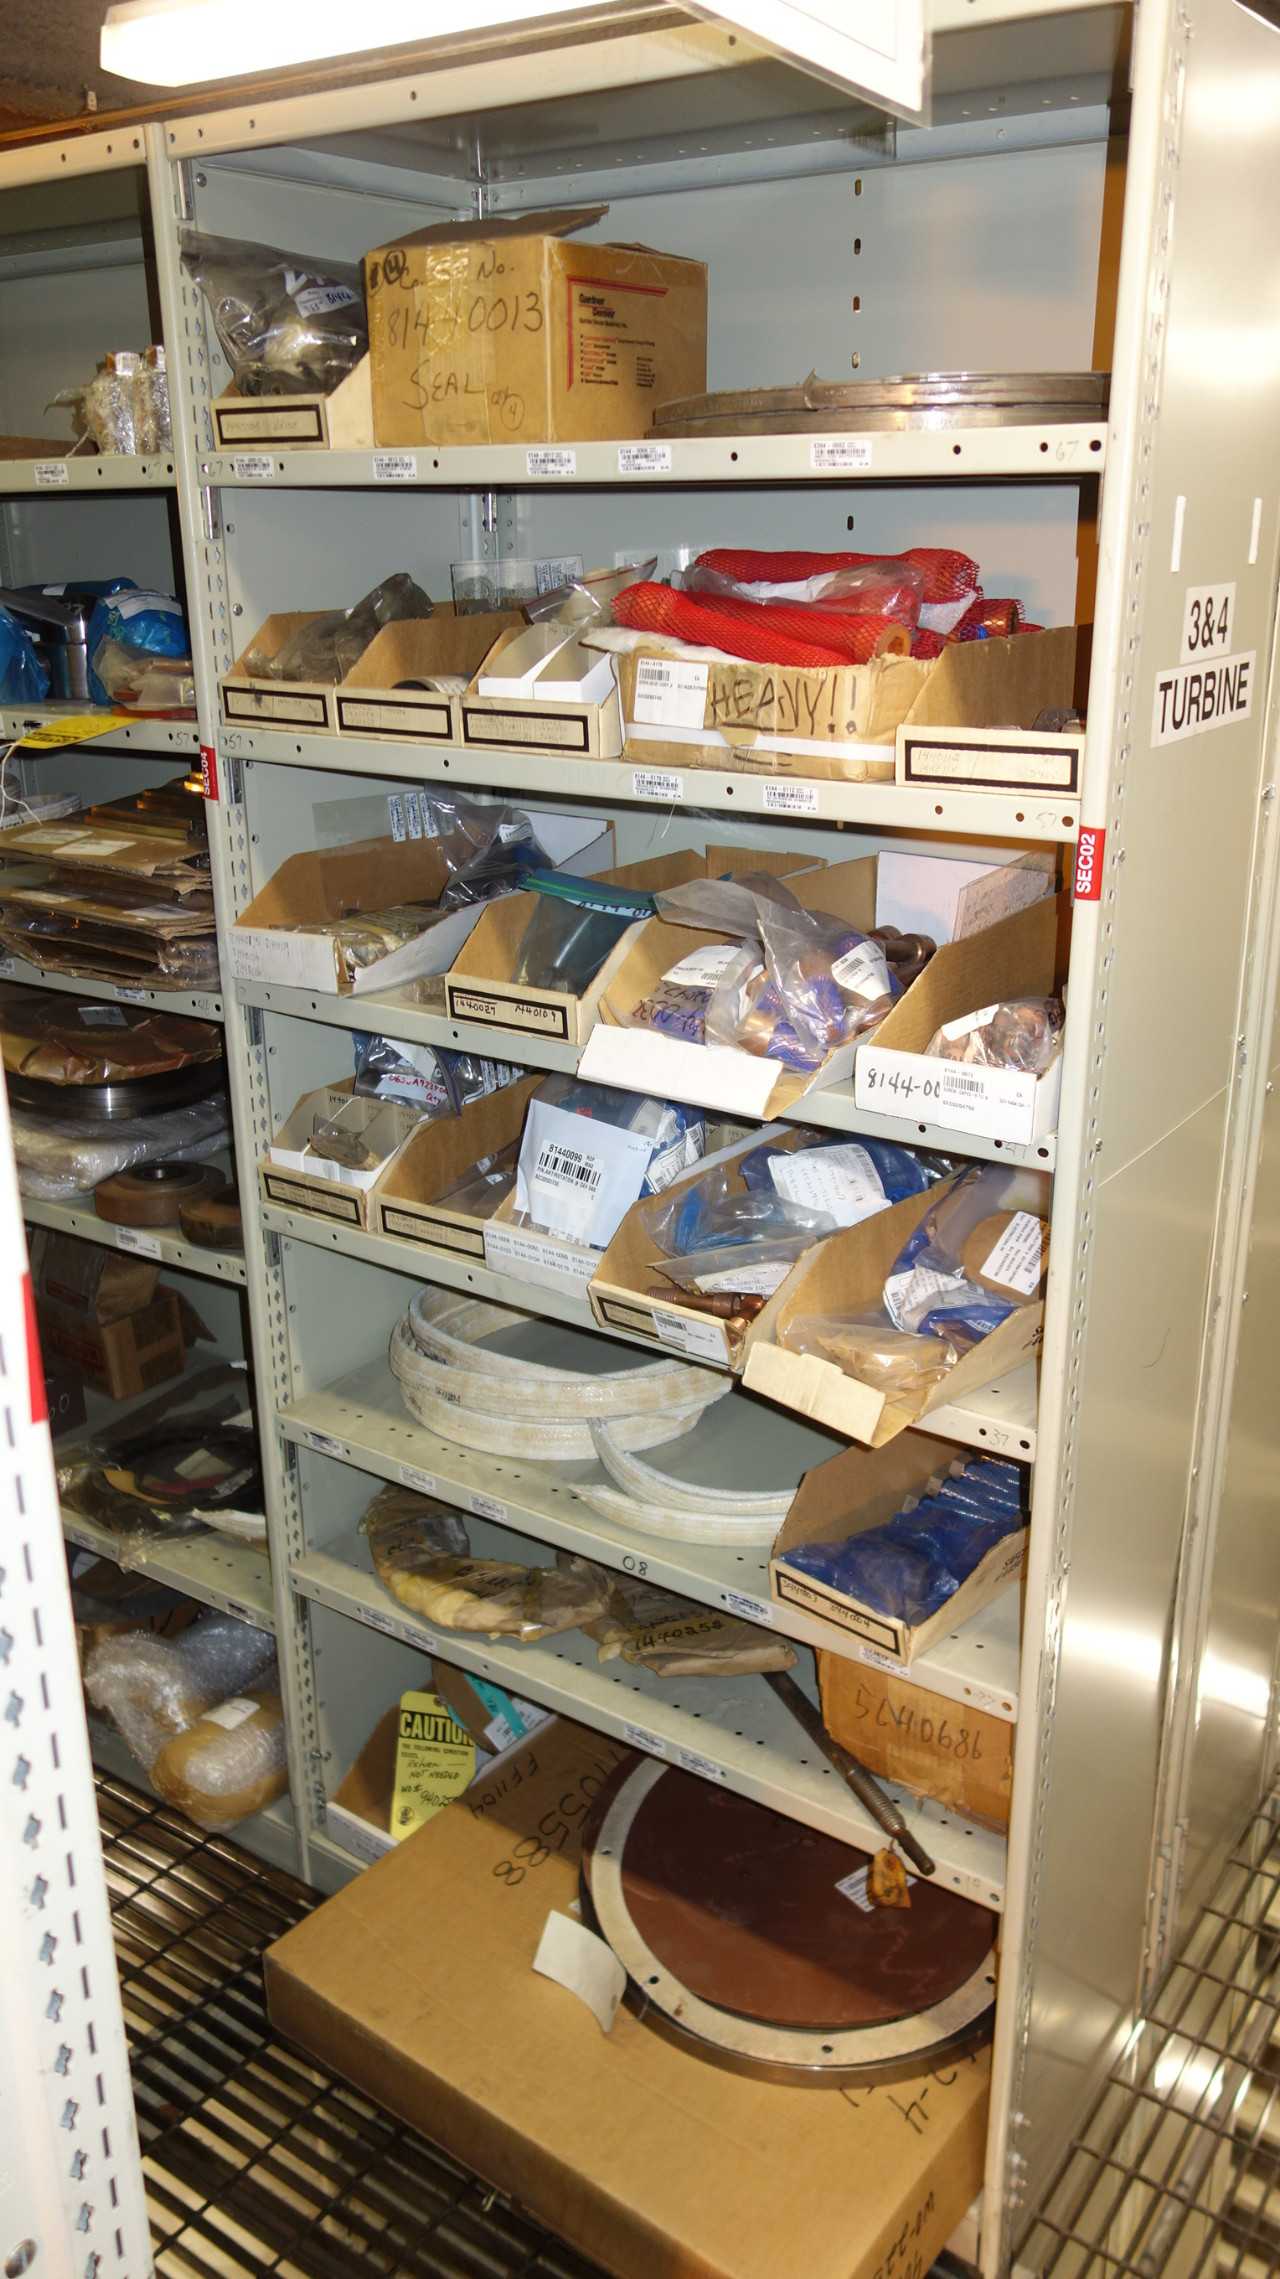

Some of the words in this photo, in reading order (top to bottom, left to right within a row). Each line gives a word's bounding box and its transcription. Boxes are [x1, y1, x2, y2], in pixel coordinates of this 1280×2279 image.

[401, 359, 485, 410] SEAL
[1187, 596, 1229, 651] 3&4
[1158, 661, 1250, 734] TURBINE
[200, 751, 211, 797] SEC04
[1075, 832, 1096, 894] SEC02
